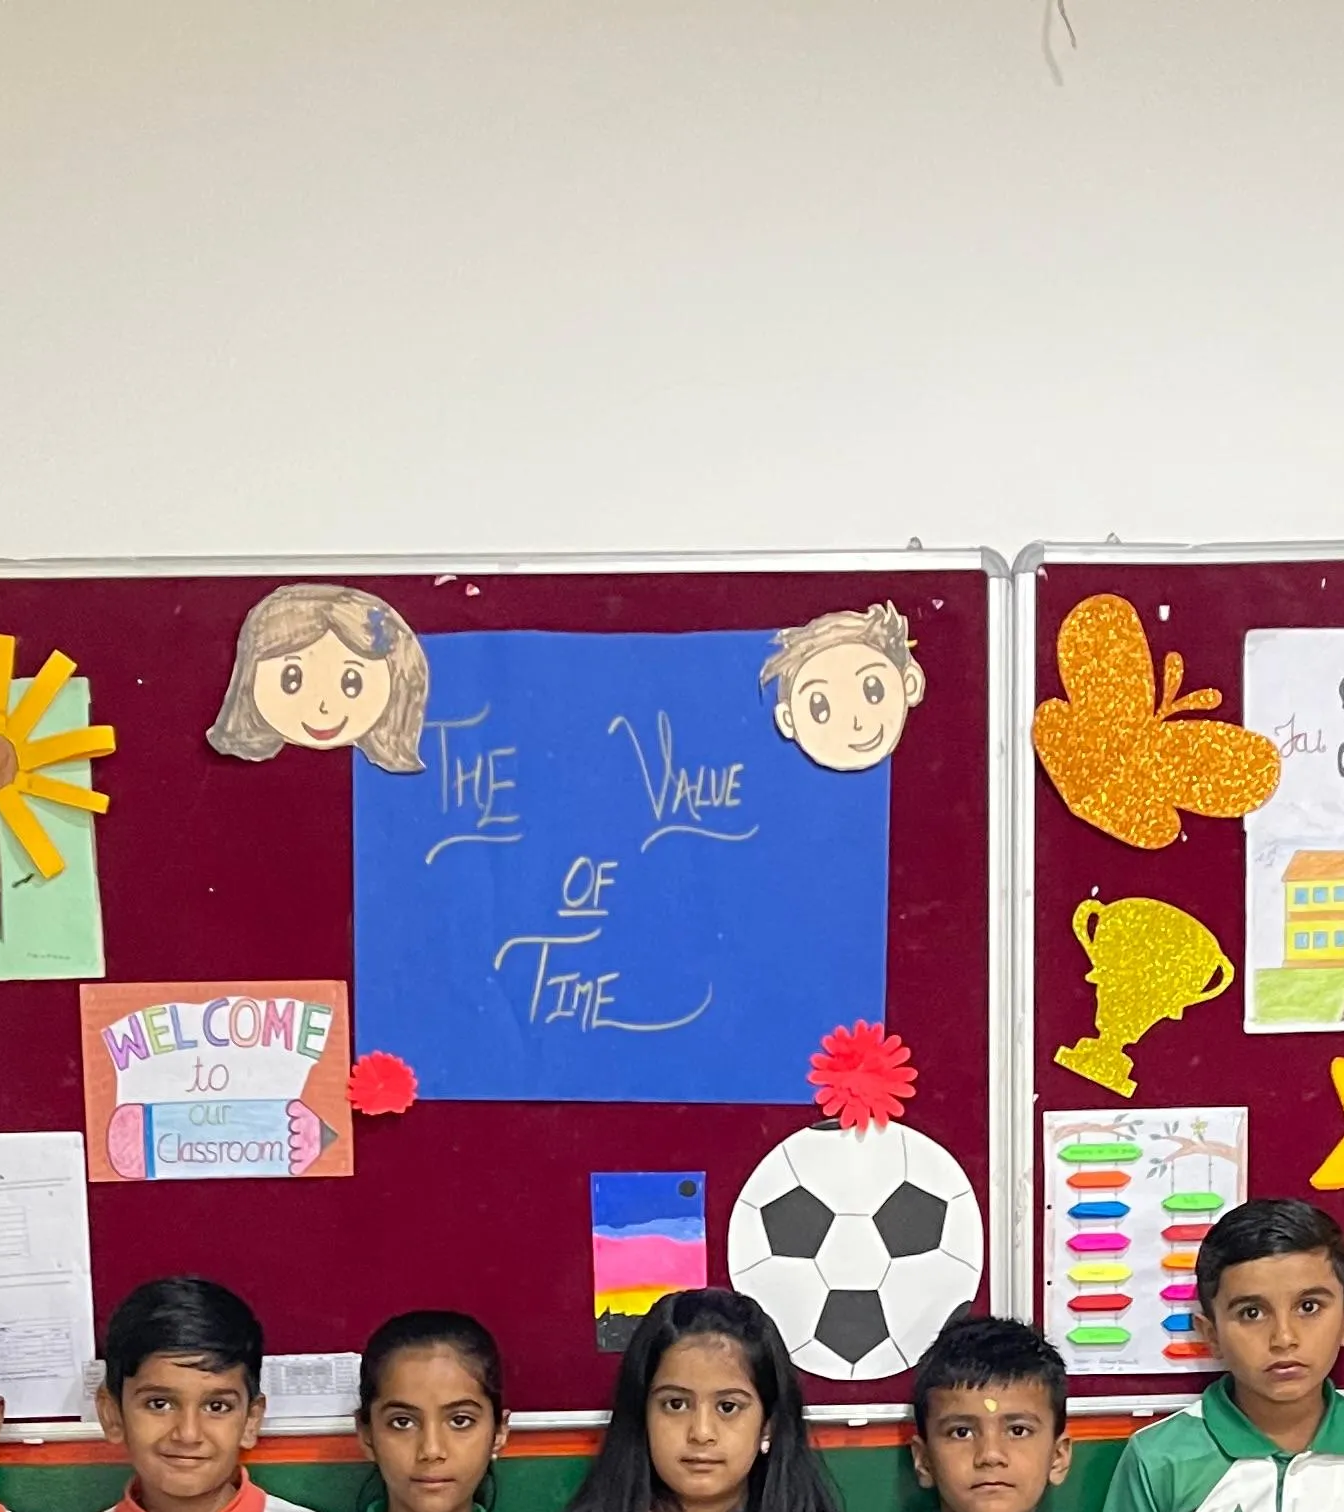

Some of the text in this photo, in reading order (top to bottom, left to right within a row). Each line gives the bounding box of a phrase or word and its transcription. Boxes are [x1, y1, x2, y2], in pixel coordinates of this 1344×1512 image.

[423, 704, 745, 829] THE VALUE
[562, 856, 618, 908] OF
[494, 928, 713, 1031] TIME
[103, 997, 333, 1072] WELCOME
[185, 1055, 230, 1093] to
[188, 1103, 232, 1126] our
[156, 1132, 285, 1164] Classroom
